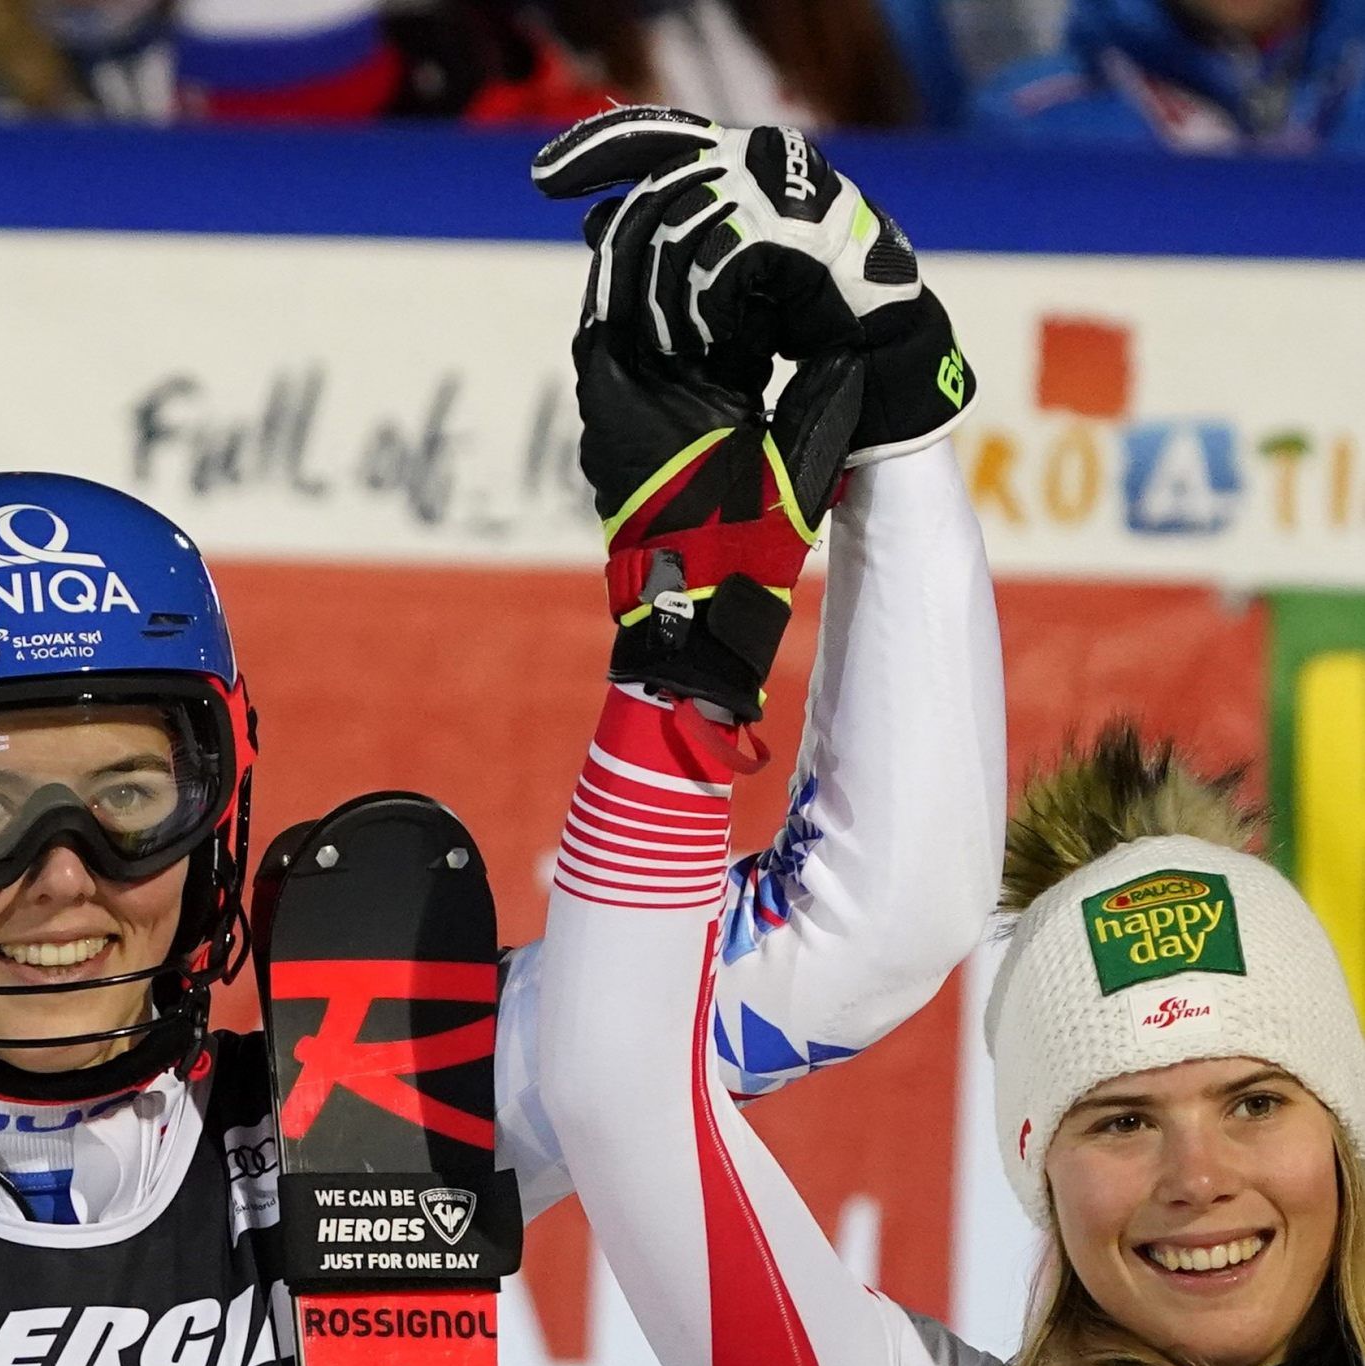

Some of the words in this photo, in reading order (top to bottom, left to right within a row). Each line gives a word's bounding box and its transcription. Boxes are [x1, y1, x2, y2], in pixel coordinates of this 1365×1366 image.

[358, 368, 462, 523] of
[13, 633, 76, 648] SLOVAK
[78, 630, 102, 645] SKI
[1129, 881, 1195, 901] RAUCH
[1094, 900, 1224, 944] happy
[1129, 931, 1206, 964] day
[314, 1189, 346, 1206] WE
[348, 1189, 387, 1206] CAN
[390, 1189, 416, 1206] BE
[317, 1217, 426, 1243] HEROES
[319, 1253, 364, 1270] JUST
[368, 1253, 403, 1269] FOR
[405, 1253, 443, 1269] ONE
[445, 1253, 480, 1269] DAY
[305, 1308, 497, 1338] ROSSIGNOL
